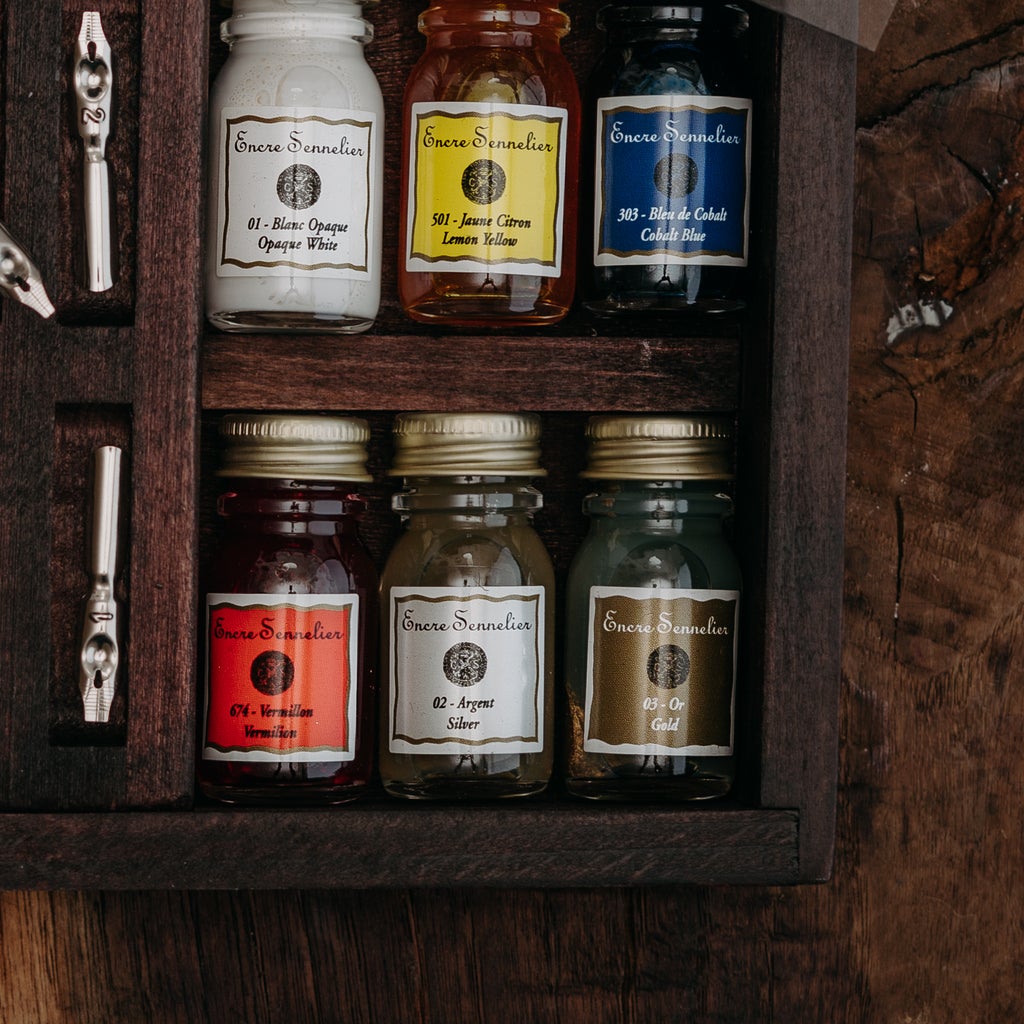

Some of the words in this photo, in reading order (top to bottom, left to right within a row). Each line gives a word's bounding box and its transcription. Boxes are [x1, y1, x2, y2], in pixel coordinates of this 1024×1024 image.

[423, 126, 470, 148] Encre
[472, 126, 554, 152] Sennelier
[610, 121, 660, 144] Encre
[663, 120, 741, 144] Sennelier
[234, 130, 285, 153] Encre
[287, 130, 364, 157] Sennelier
[431, 213, 450, 227] 501
[458, 213, 492, 229] Jaune
[496, 214, 531, 228] Citron
[617, 208, 639, 222] 303
[649, 207, 675, 220] Bleu
[677, 206, 691, 220] de
[694, 207, 727, 221] Cobalt
[272, 217, 305, 230] Blanc
[308, 218, 348, 236] Opaque
[442, 232, 479, 245] Lemon
[482, 232, 518, 247] Yellow
[641, 228, 679, 241] Cobalt
[681, 228, 706, 242] Blue
[258, 236, 302, 253] Opaque
[307, 236, 338, 251] White
[214, 617, 259, 640] Encre
[259, 617, 344, 640] Sennelier
[402, 610, 450, 631] Encre
[453, 610, 533, 631] Sennelier
[603, 610, 654, 633] Encre
[656, 612, 729, 635] Sennelier
[229, 703, 249, 718] 674
[260, 704, 314, 718] Vermillon
[433, 697, 447, 709] 02
[457, 696, 495, 713] Argent
[643, 697, 658, 710] 03
[669, 697, 685, 710] Or
[447, 716, 480, 730] Silver
[651, 718, 680, 731] Gold
[244, 724, 297, 739] Vermilion
